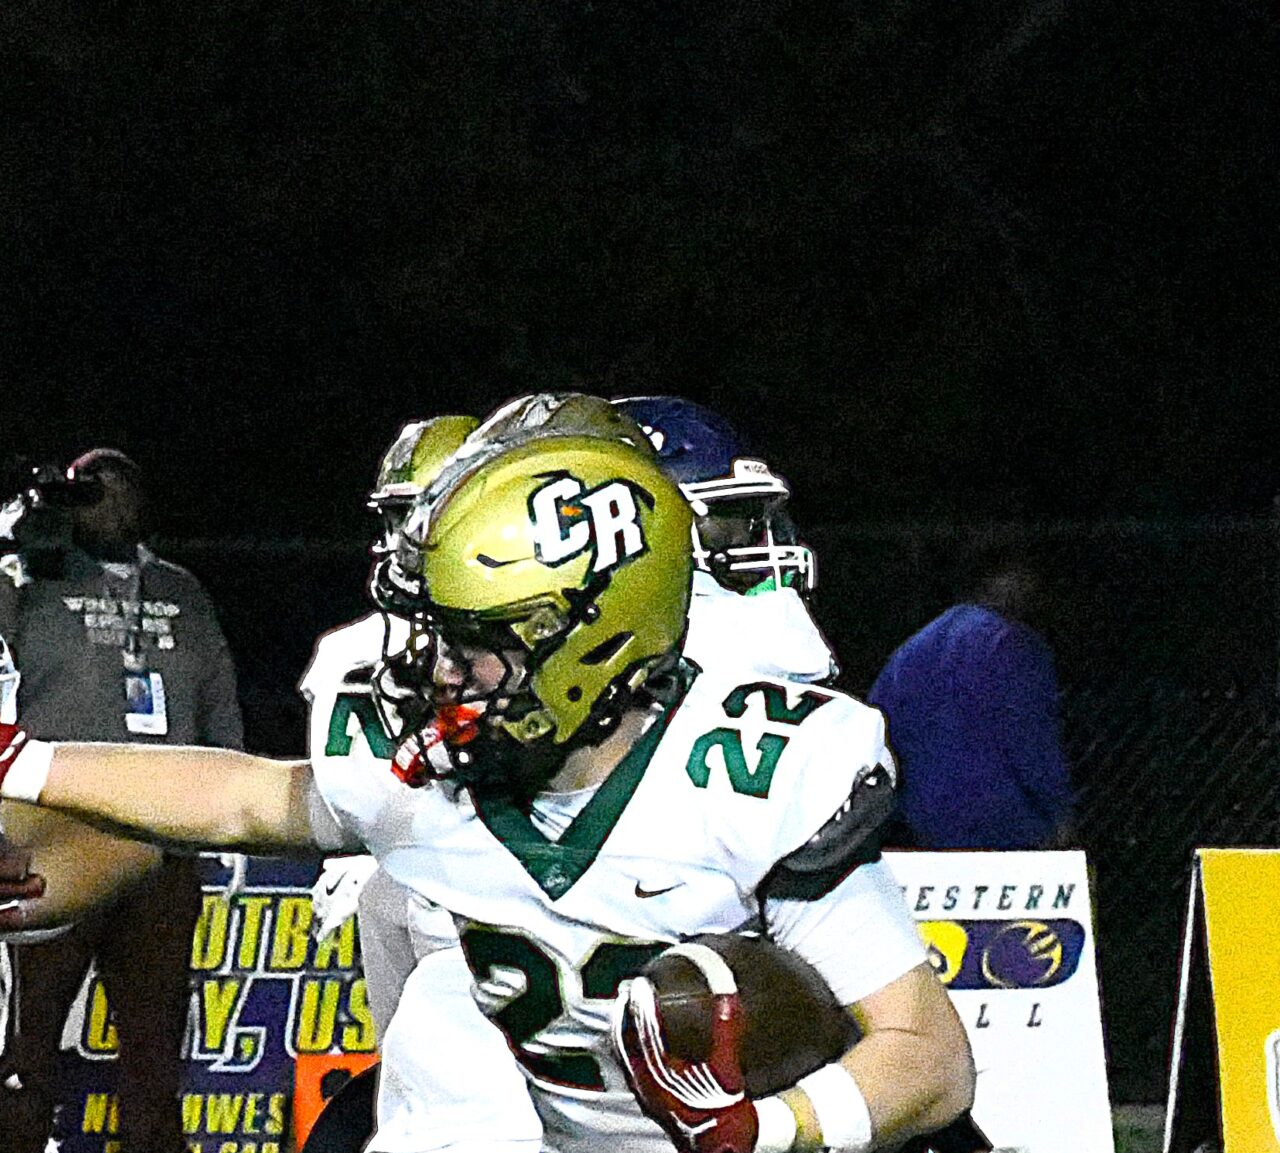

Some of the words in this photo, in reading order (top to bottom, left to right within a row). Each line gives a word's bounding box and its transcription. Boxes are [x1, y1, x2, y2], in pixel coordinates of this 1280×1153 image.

[531, 477, 644, 573] CR
[684, 681, 836, 800] 22
[901, 882, 1076, 912] ESTERN
[296, 979, 378, 1051] US
